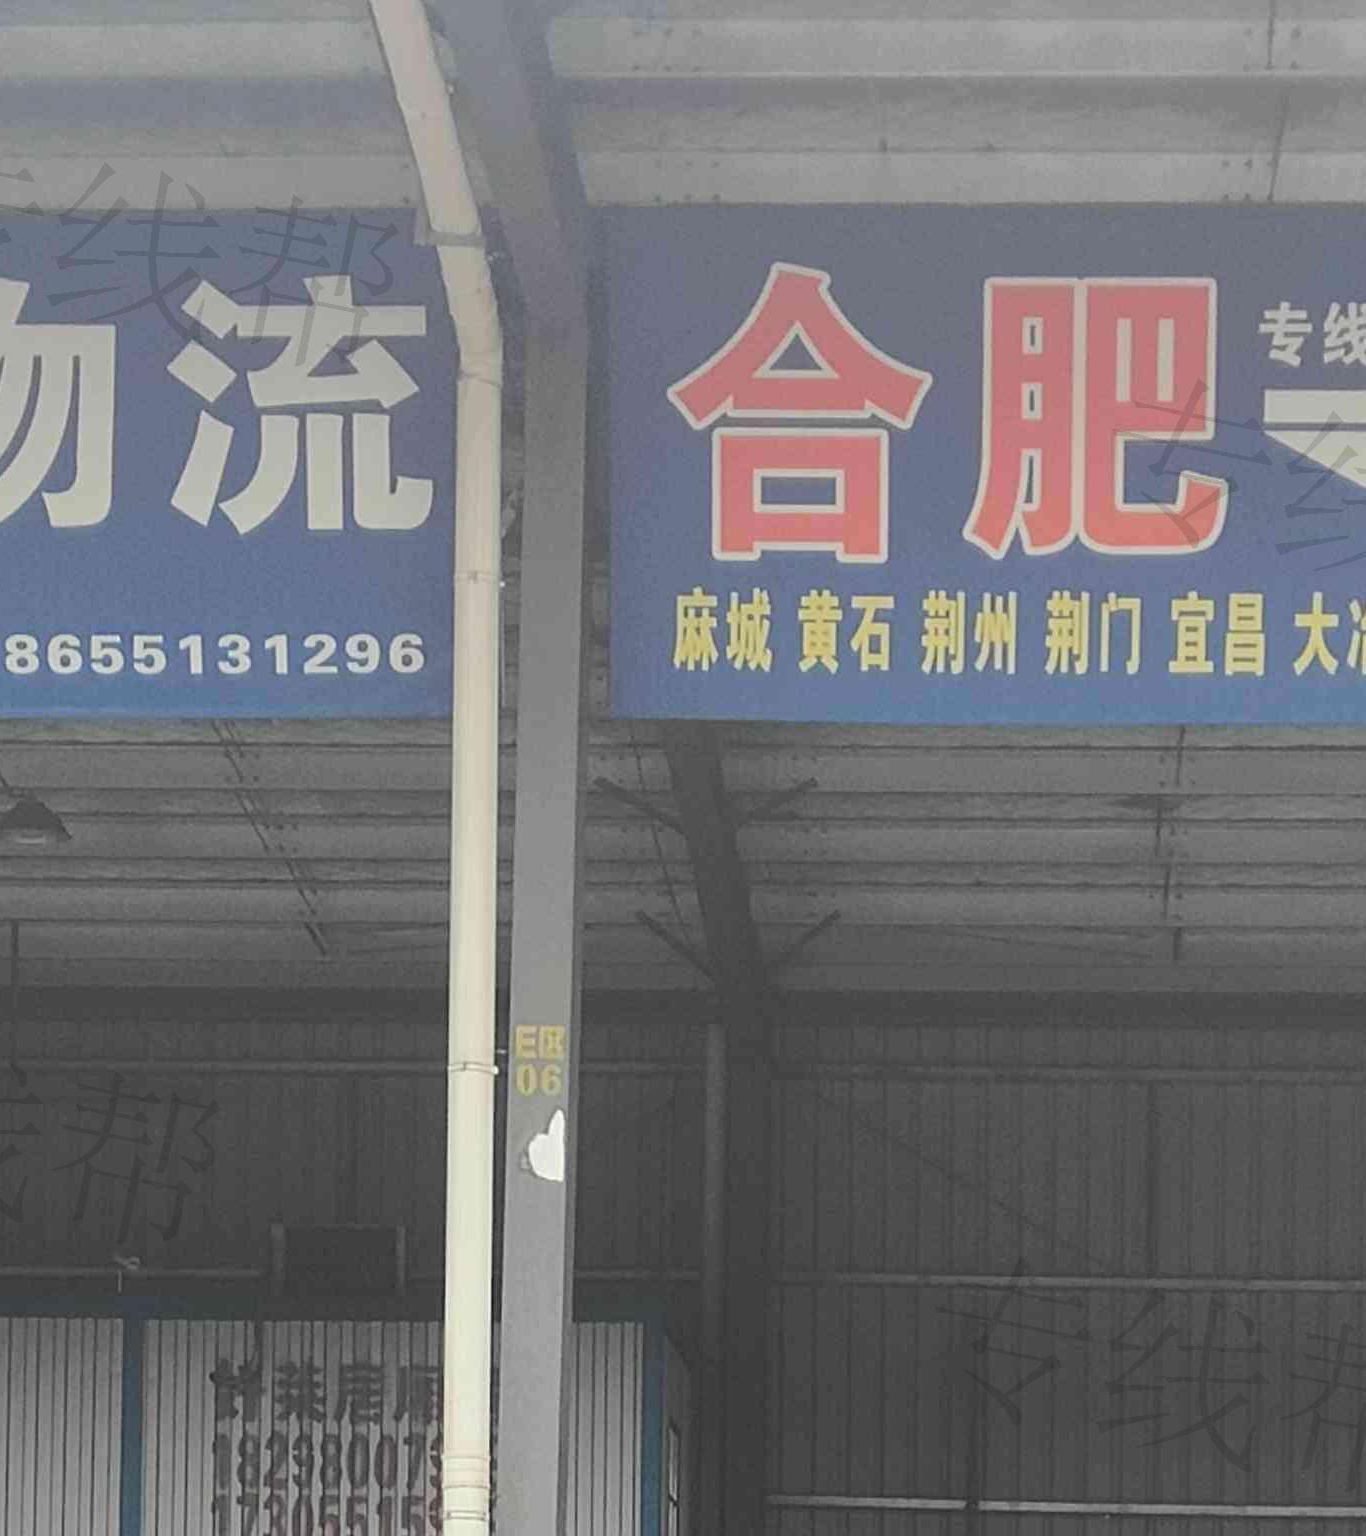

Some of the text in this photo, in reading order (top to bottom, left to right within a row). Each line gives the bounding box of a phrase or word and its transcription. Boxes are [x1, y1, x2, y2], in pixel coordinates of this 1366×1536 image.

[667, 261, 1229, 563] 合肥
[672, 588, 772, 671] 麻城
[797, 590, 894, 672] 黄石
[921, 590, 1018, 674] 荆州
[1045, 591, 1142, 674] 荆门
[1169, 591, 1267, 676] 宜昌
[515, 1064, 563, 1097] 06
